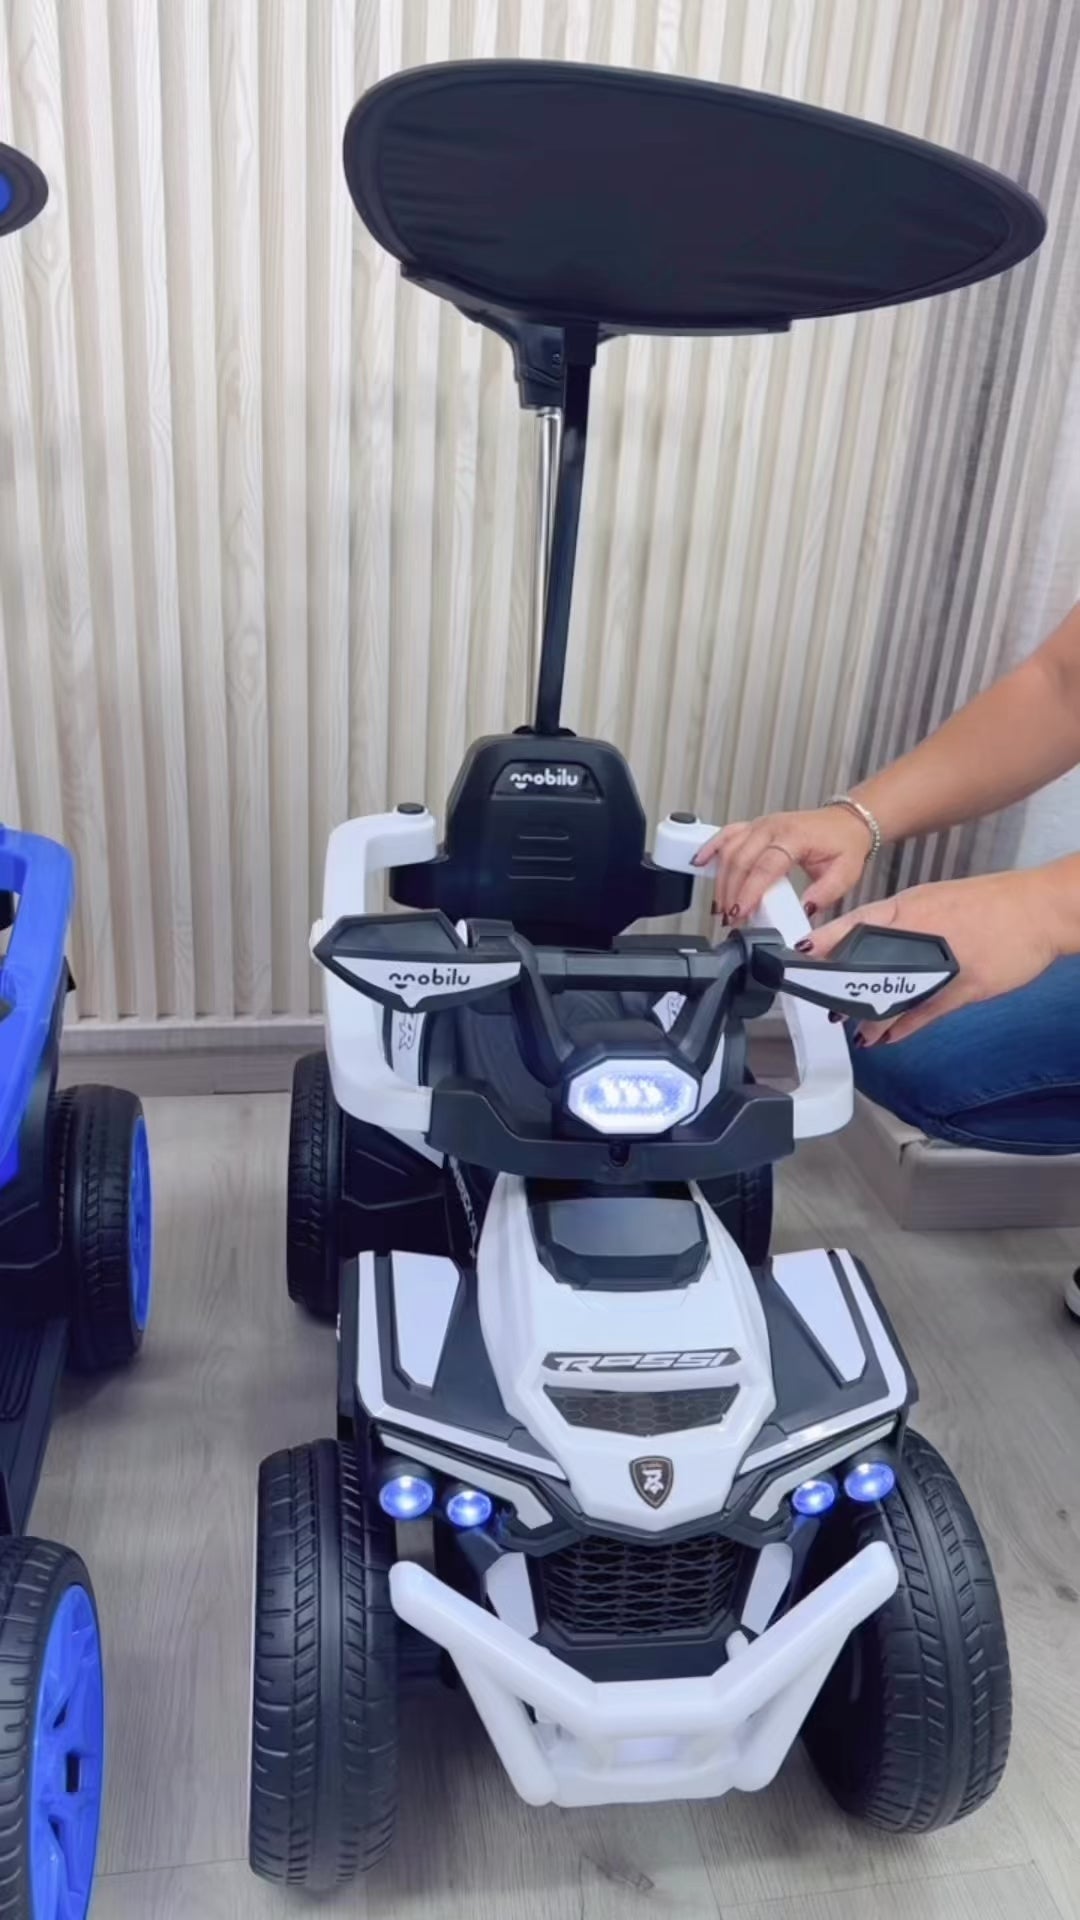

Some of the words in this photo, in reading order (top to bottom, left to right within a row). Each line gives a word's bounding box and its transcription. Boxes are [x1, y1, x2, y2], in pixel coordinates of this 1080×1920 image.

[509, 767, 579, 790] mobilu
[388, 967, 471, 990] mobilu
[845, 976, 917, 997] mobilu
[553, 1351, 732, 1373] ROSSI
